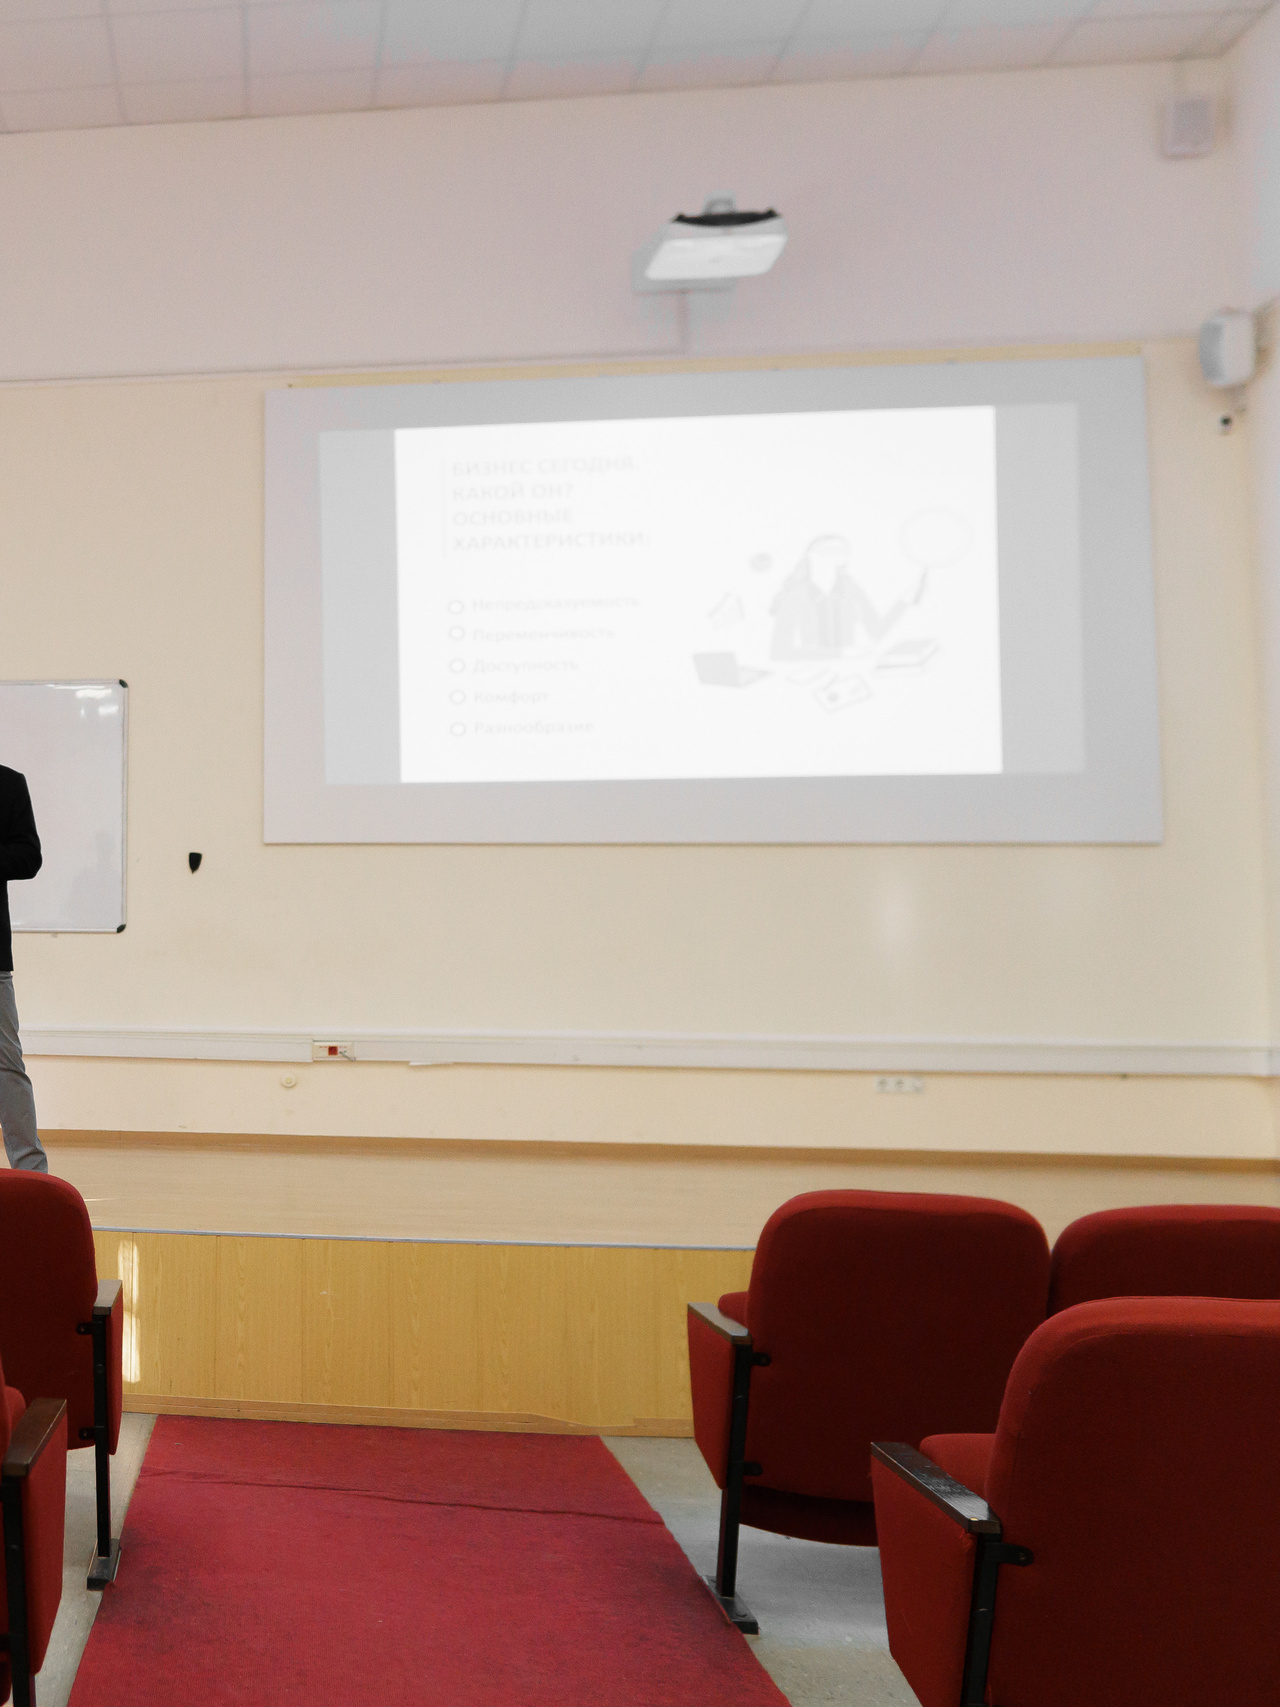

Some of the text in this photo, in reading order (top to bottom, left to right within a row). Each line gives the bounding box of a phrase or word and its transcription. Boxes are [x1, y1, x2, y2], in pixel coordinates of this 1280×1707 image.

[452, 459, 532, 476] БИЗНЕС
[452, 480, 574, 500] КАКОЙ ОН?
[452, 508, 574, 527] ОСНОВНЫЕ
[472, 597, 641, 613] Непредсказуемость
[473, 659, 579, 675] Доступность
[473, 691, 550, 705] Комфорт
[474, 719, 595, 735] Разнообразие
